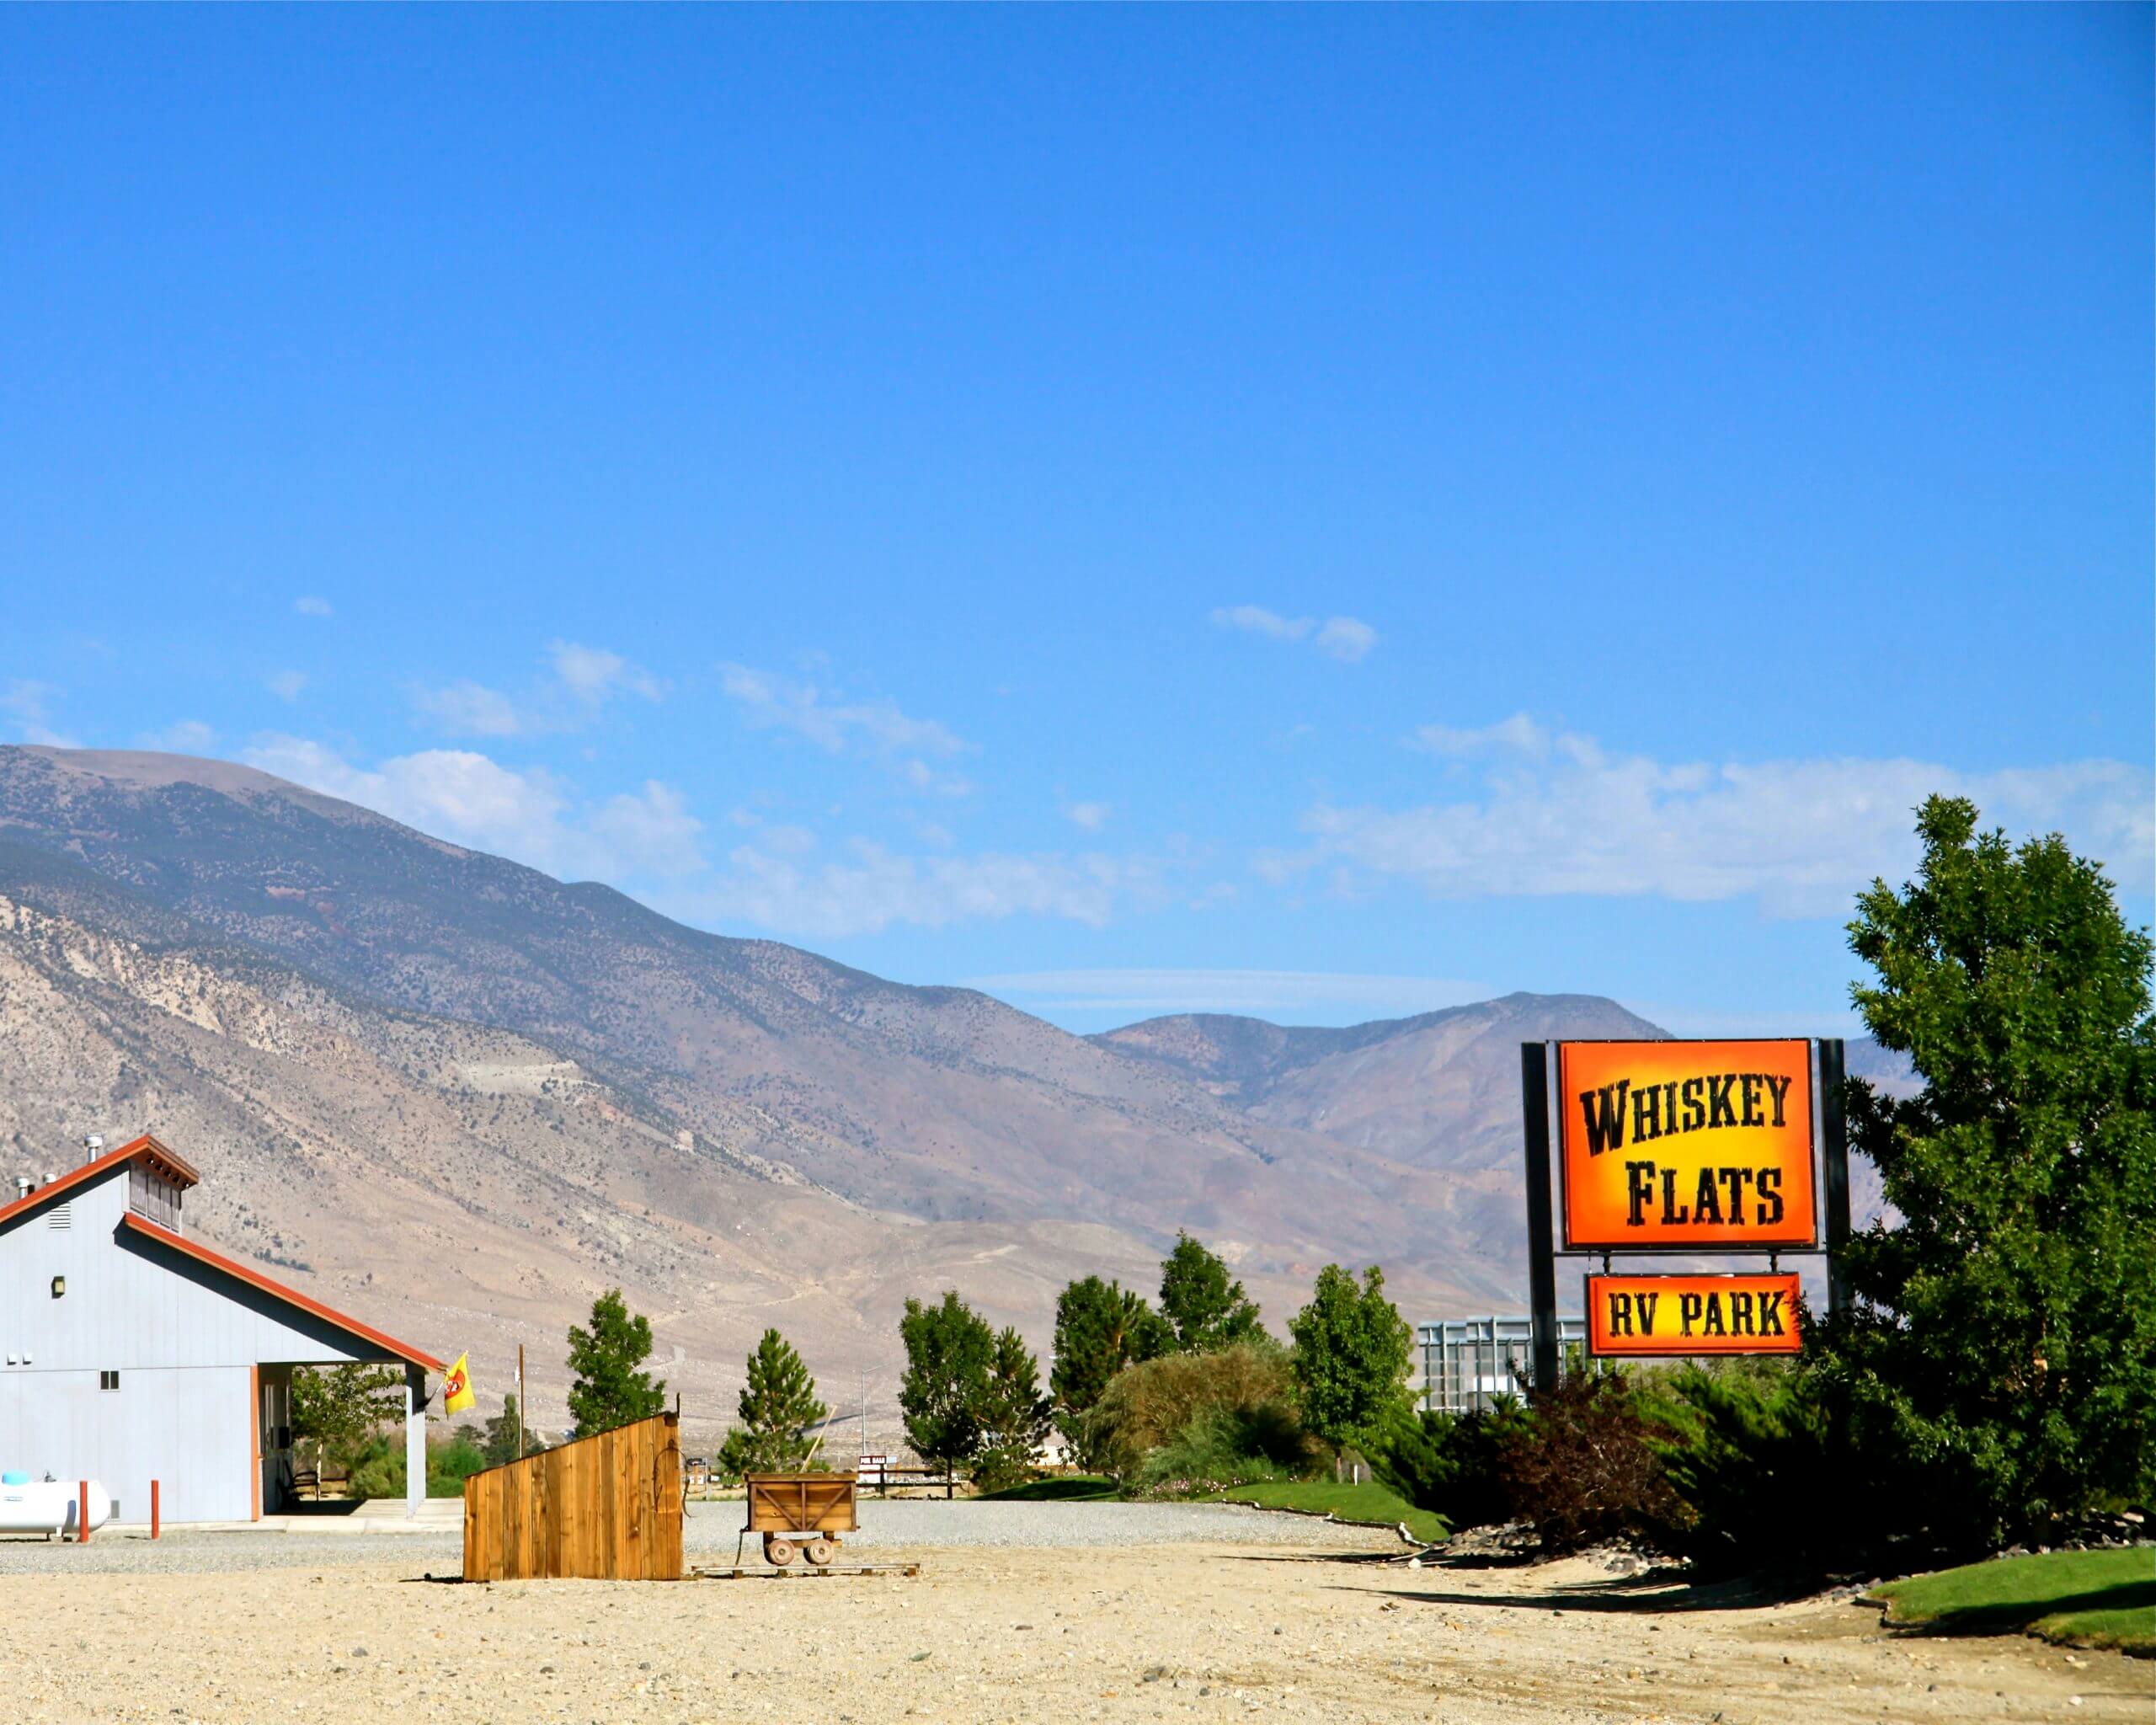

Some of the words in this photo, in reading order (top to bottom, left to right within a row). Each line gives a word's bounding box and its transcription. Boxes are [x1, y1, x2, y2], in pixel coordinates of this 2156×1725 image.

[1579, 1073, 1792, 1157] WHISKEY
[1625, 1161, 1784, 1226] FLATS
[1609, 1292, 1658, 1337] RV
[1678, 1291, 1785, 1337] PARK
